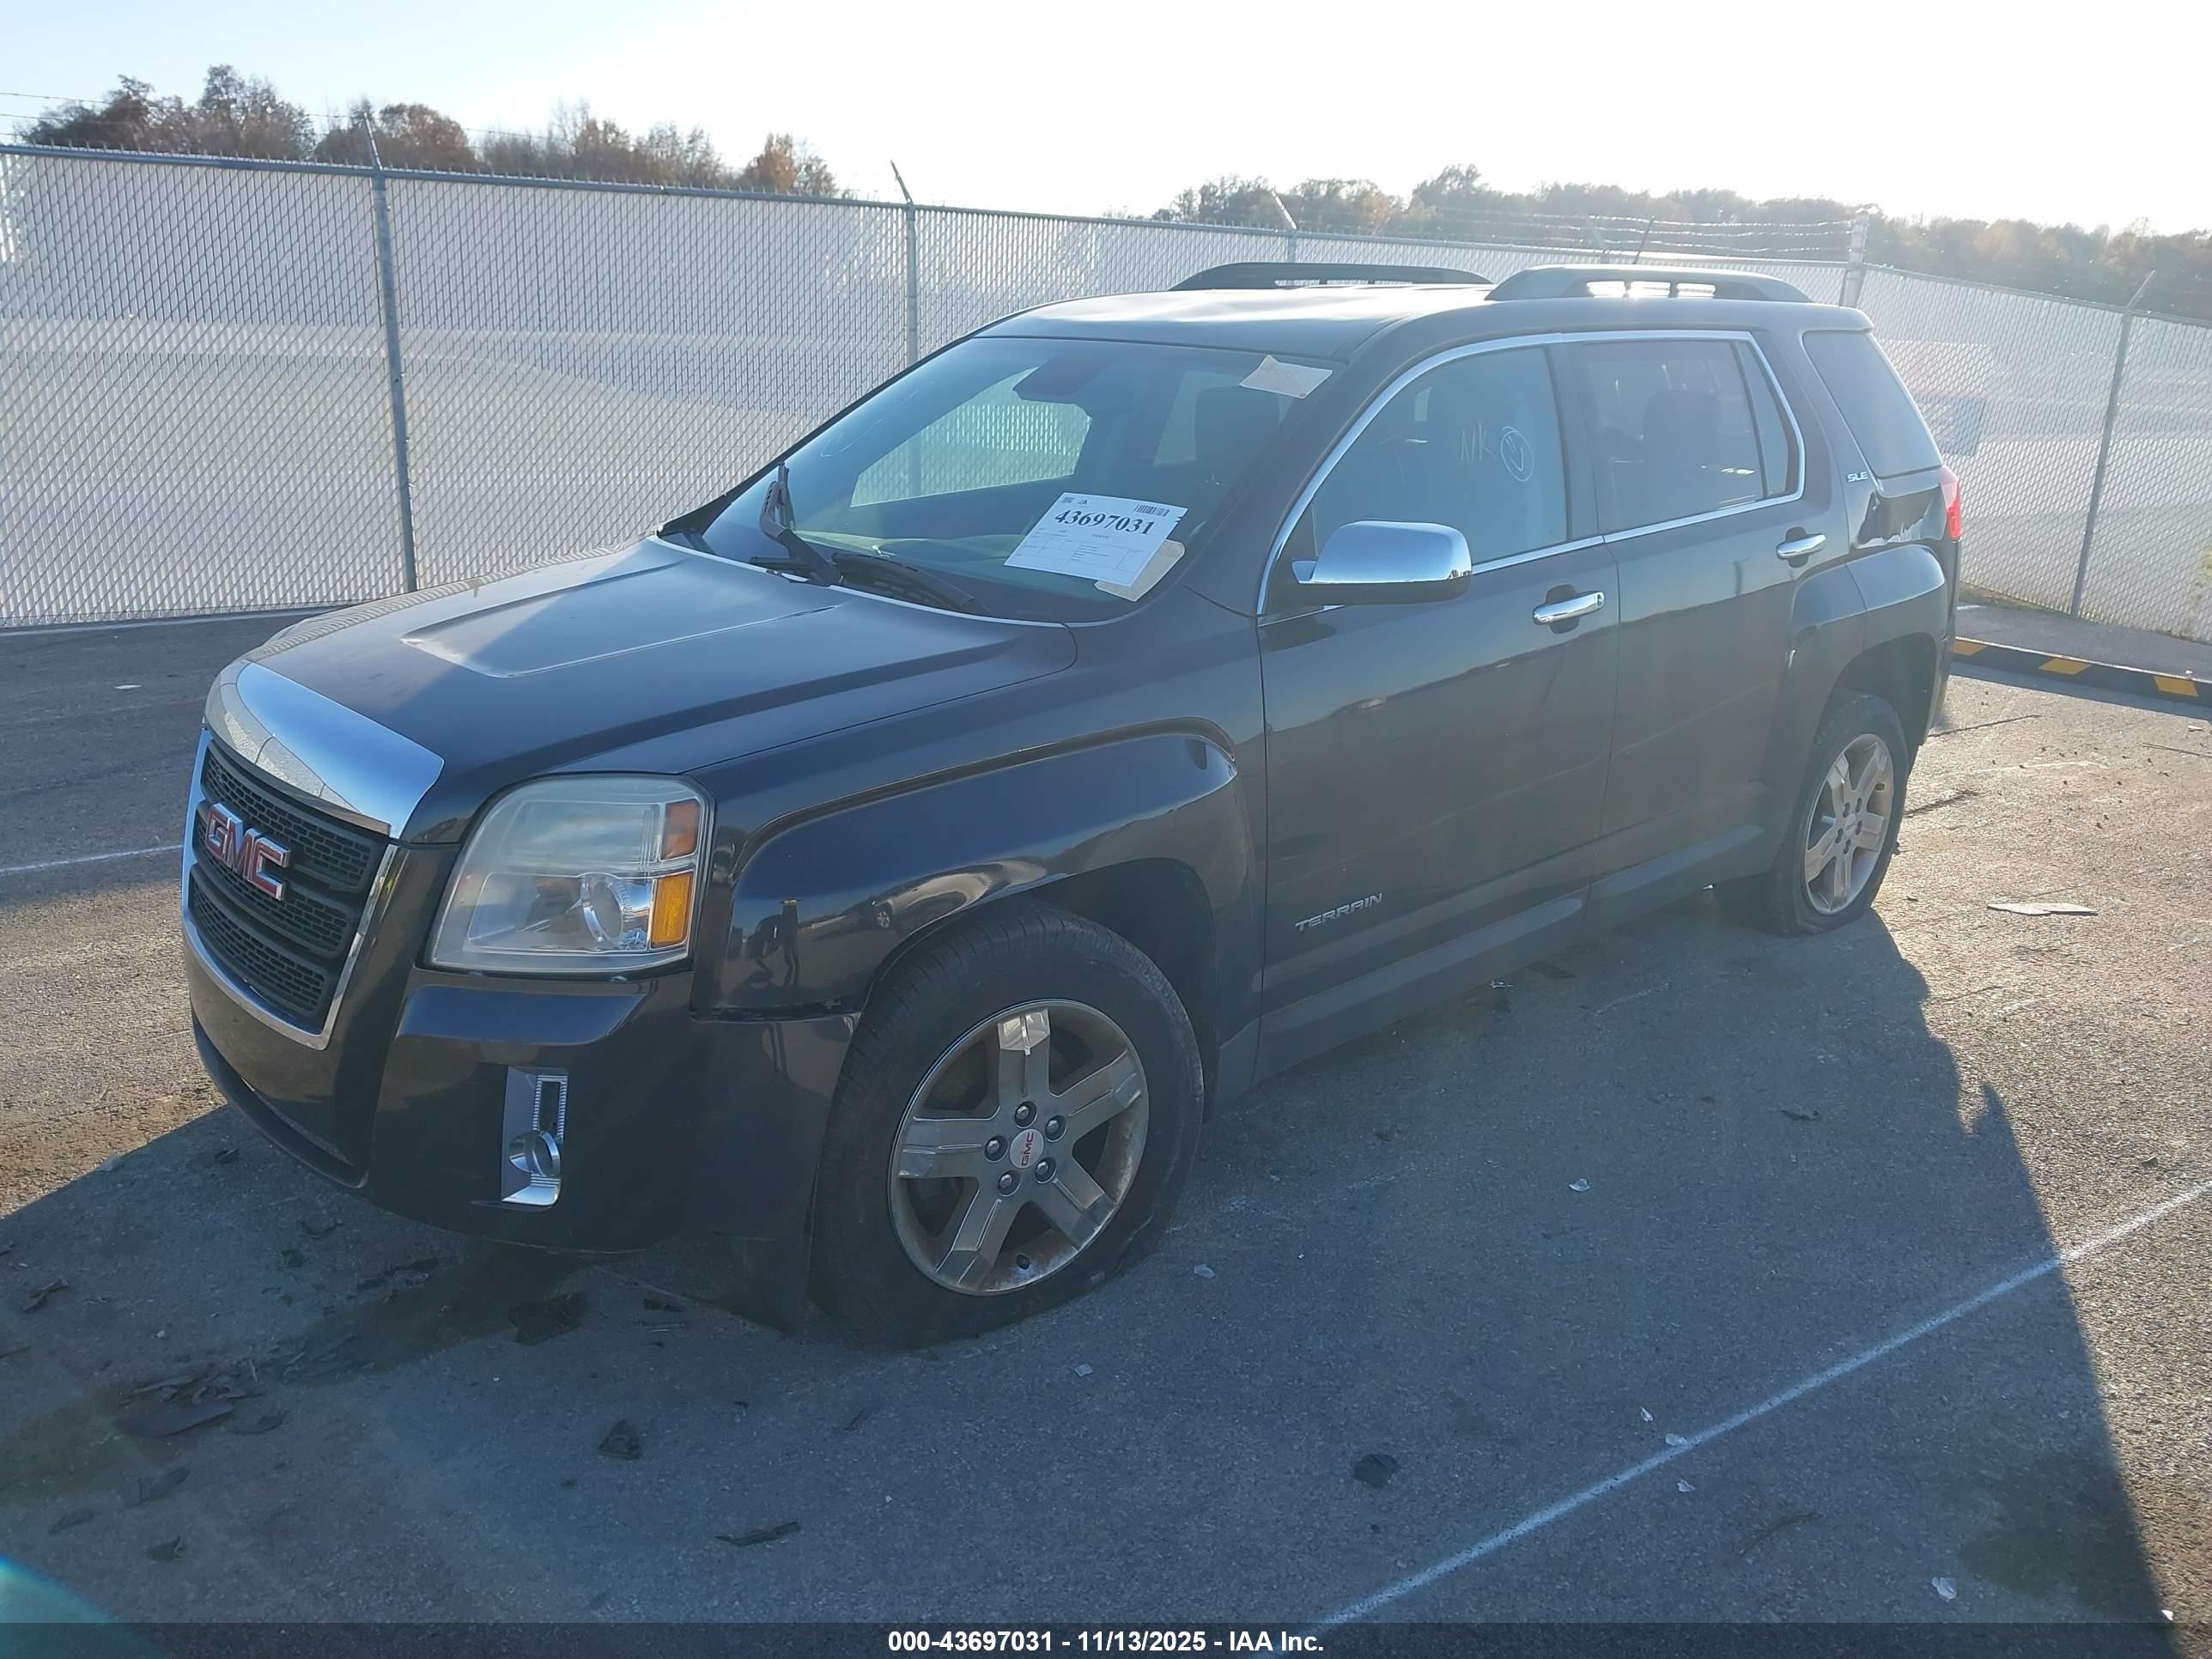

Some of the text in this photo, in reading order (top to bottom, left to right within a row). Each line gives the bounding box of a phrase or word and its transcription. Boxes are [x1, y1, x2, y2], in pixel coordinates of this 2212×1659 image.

[1847, 471, 1869, 483] SLE
[1054, 509, 1155, 535] 43697031
[205, 803, 290, 901] GMC
[1295, 893, 1382, 931] TERRAIN
[1021, 1132, 1035, 1166] GMC
